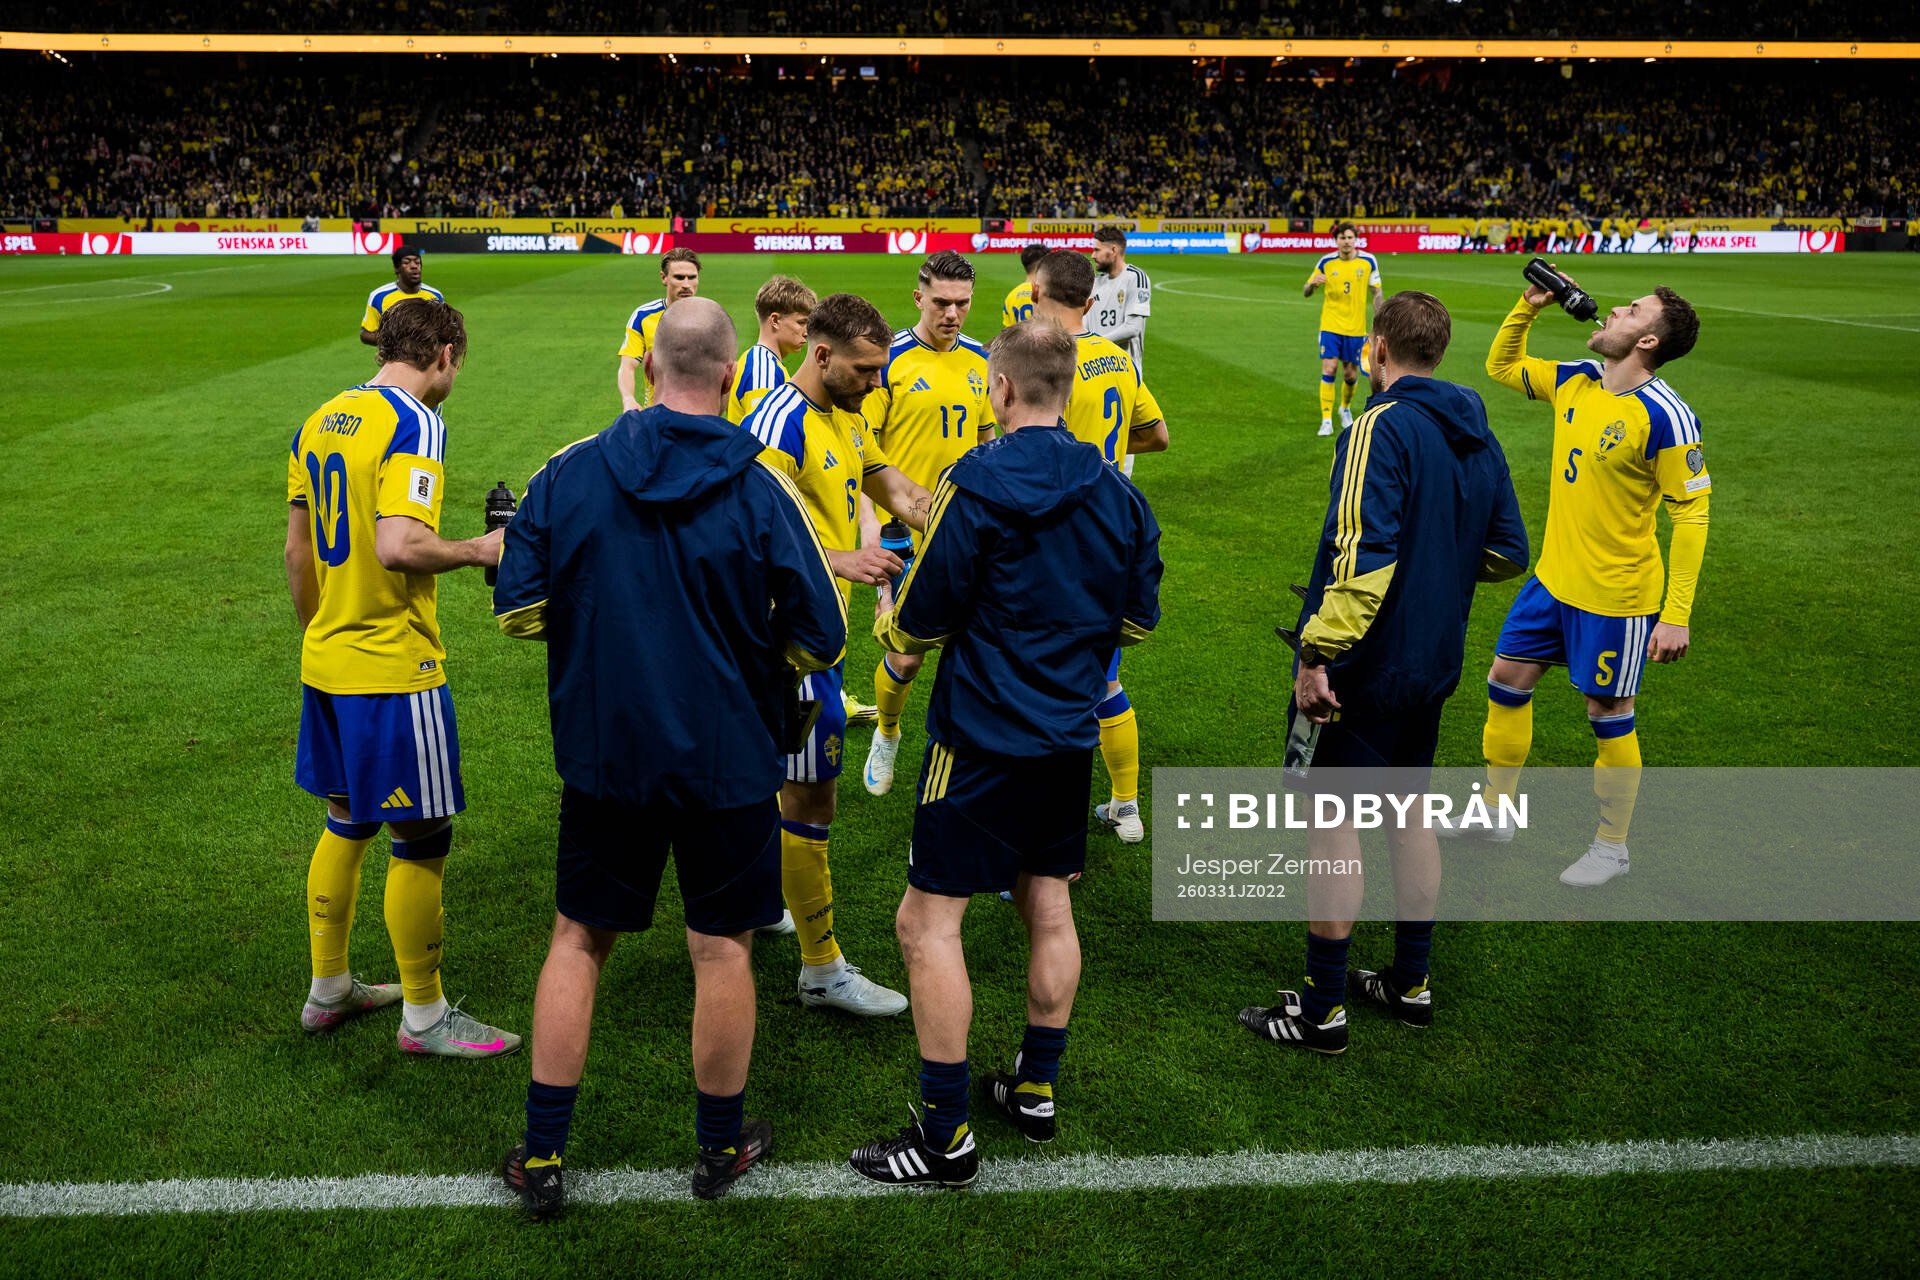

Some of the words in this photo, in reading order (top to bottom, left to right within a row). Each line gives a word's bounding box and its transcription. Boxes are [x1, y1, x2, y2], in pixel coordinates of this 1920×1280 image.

[4, 236, 36, 250] SPEL
[217, 237, 275, 249] SVENSKA
[279, 237, 308, 249] SPEL
[487, 236, 546, 250] SVENSKA
[548, 236, 579, 250] SPEL
[754, 236, 812, 250] SVENSKA
[814, 236, 845, 250] SPEL
[990, 238, 1042, 248] EUROPEAN
[1262, 238, 1312, 248] EUROPEAN
[1730, 236, 1757, 248] SPEL
[1344, 282, 1350, 294] 3
[1100, 310, 1116, 326] 23
[940, 404, 966, 438] 17
[1104, 386, 1122, 469] 2
[1564, 448, 1582, 483] 5
[306, 450, 350, 567] 10
[1596, 650, 1617, 686] 5
